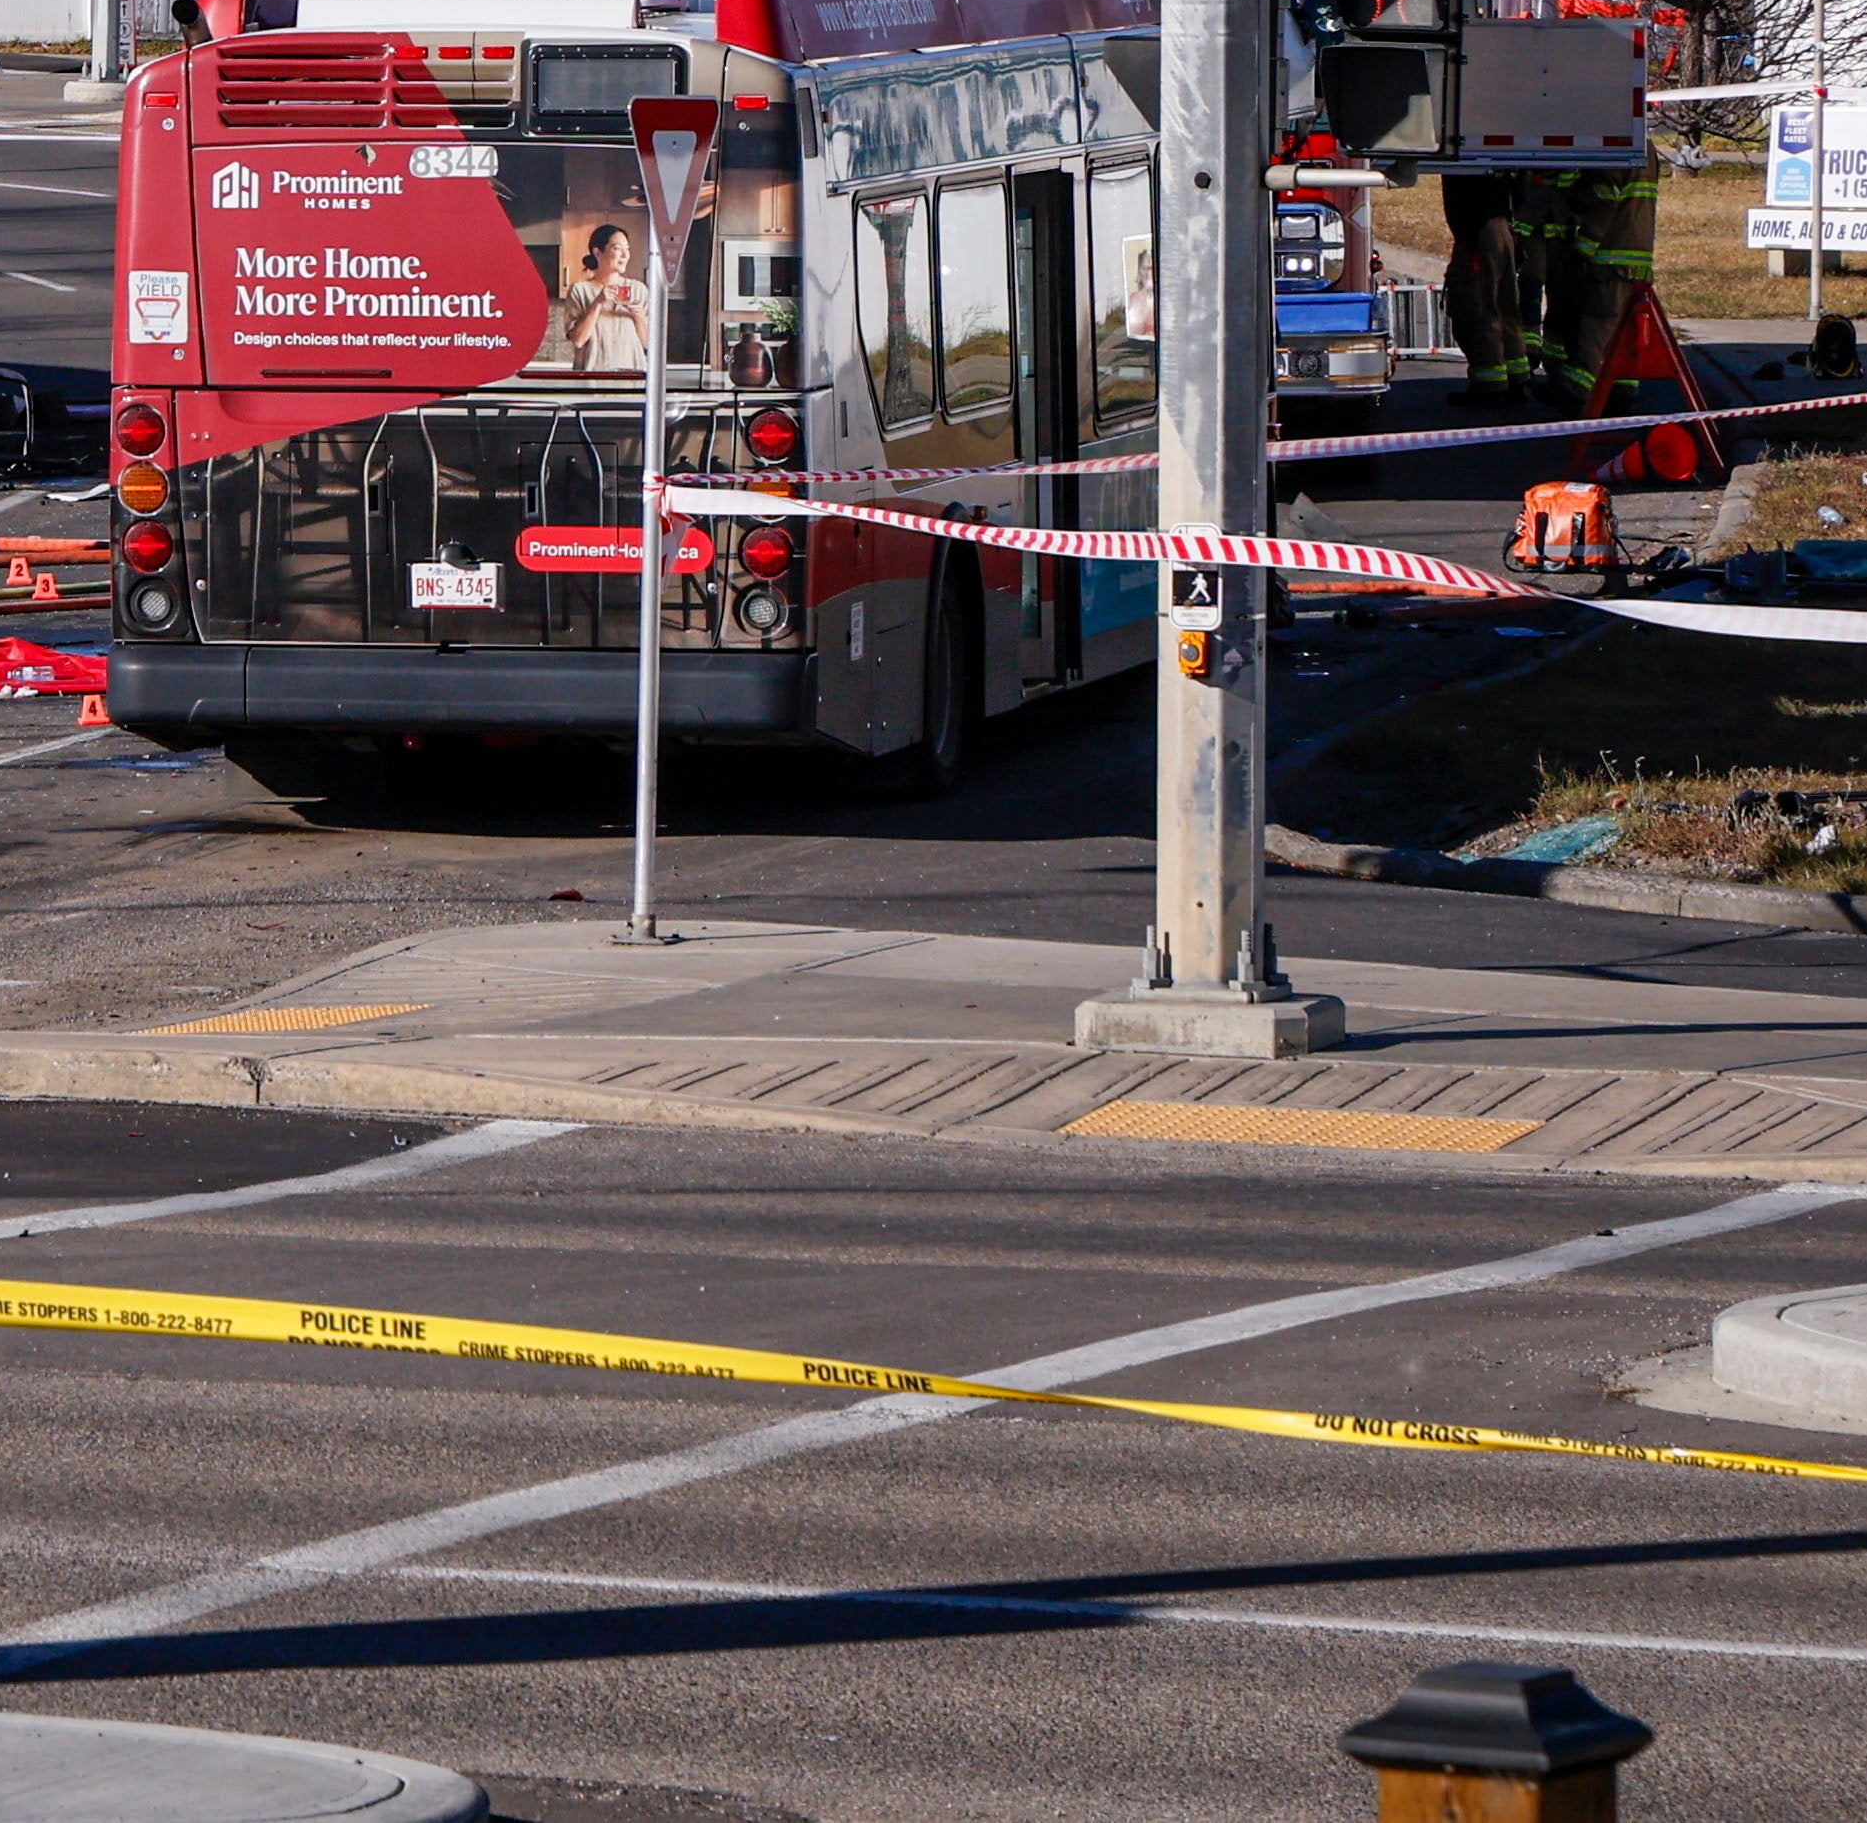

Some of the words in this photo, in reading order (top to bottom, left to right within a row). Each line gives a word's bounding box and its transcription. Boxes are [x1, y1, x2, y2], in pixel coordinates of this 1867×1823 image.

[1783, 135, 1807, 144] RATES
[1784, 127, 1808, 135] FLEET
[412, 146, 498, 177] 8344
[272, 169, 403, 194] Prominent
[304, 198, 371, 209] HOMES
[1752, 219, 1795, 241] HOME,
[1837, 224, 1847, 240] &
[234, 247, 317, 279] More
[323, 248, 428, 279] Home.
[140, 274, 178, 284] Please
[136, 284, 182, 297] YIELD
[234, 285, 317, 316] More
[323, 286, 503, 318] Prominent.
[234, 332, 282, 348] Design
[284, 332, 339, 346] choices
[342, 333, 370, 346] that
[372, 333, 417, 347] reflect
[419, 336, 452, 349] your
[454, 334, 511, 350] lifestyle.
[15, 563, 23, 576] 2
[42, 579, 50, 592] 3
[416, 578, 494, 597] BNS-4345
[89, 701, 97, 716] 4
[18, 1301, 98, 1323] STOPPERS
[104, 1308, 233, 1334] 1-800-222-8477
[300, 1310, 373, 1336] POLICE
[381, 1317, 427, 1341] LINE
[458, 1340, 510, 1361] CRIME
[515, 1346, 596, 1369] STOPPERS
[802, 1361, 879, 1388] POLICE
[885, 1372, 934, 1393] LINE
[1352, 1416, 1395, 1437] NOT
[1404, 1421, 1480, 1447] CROSS
